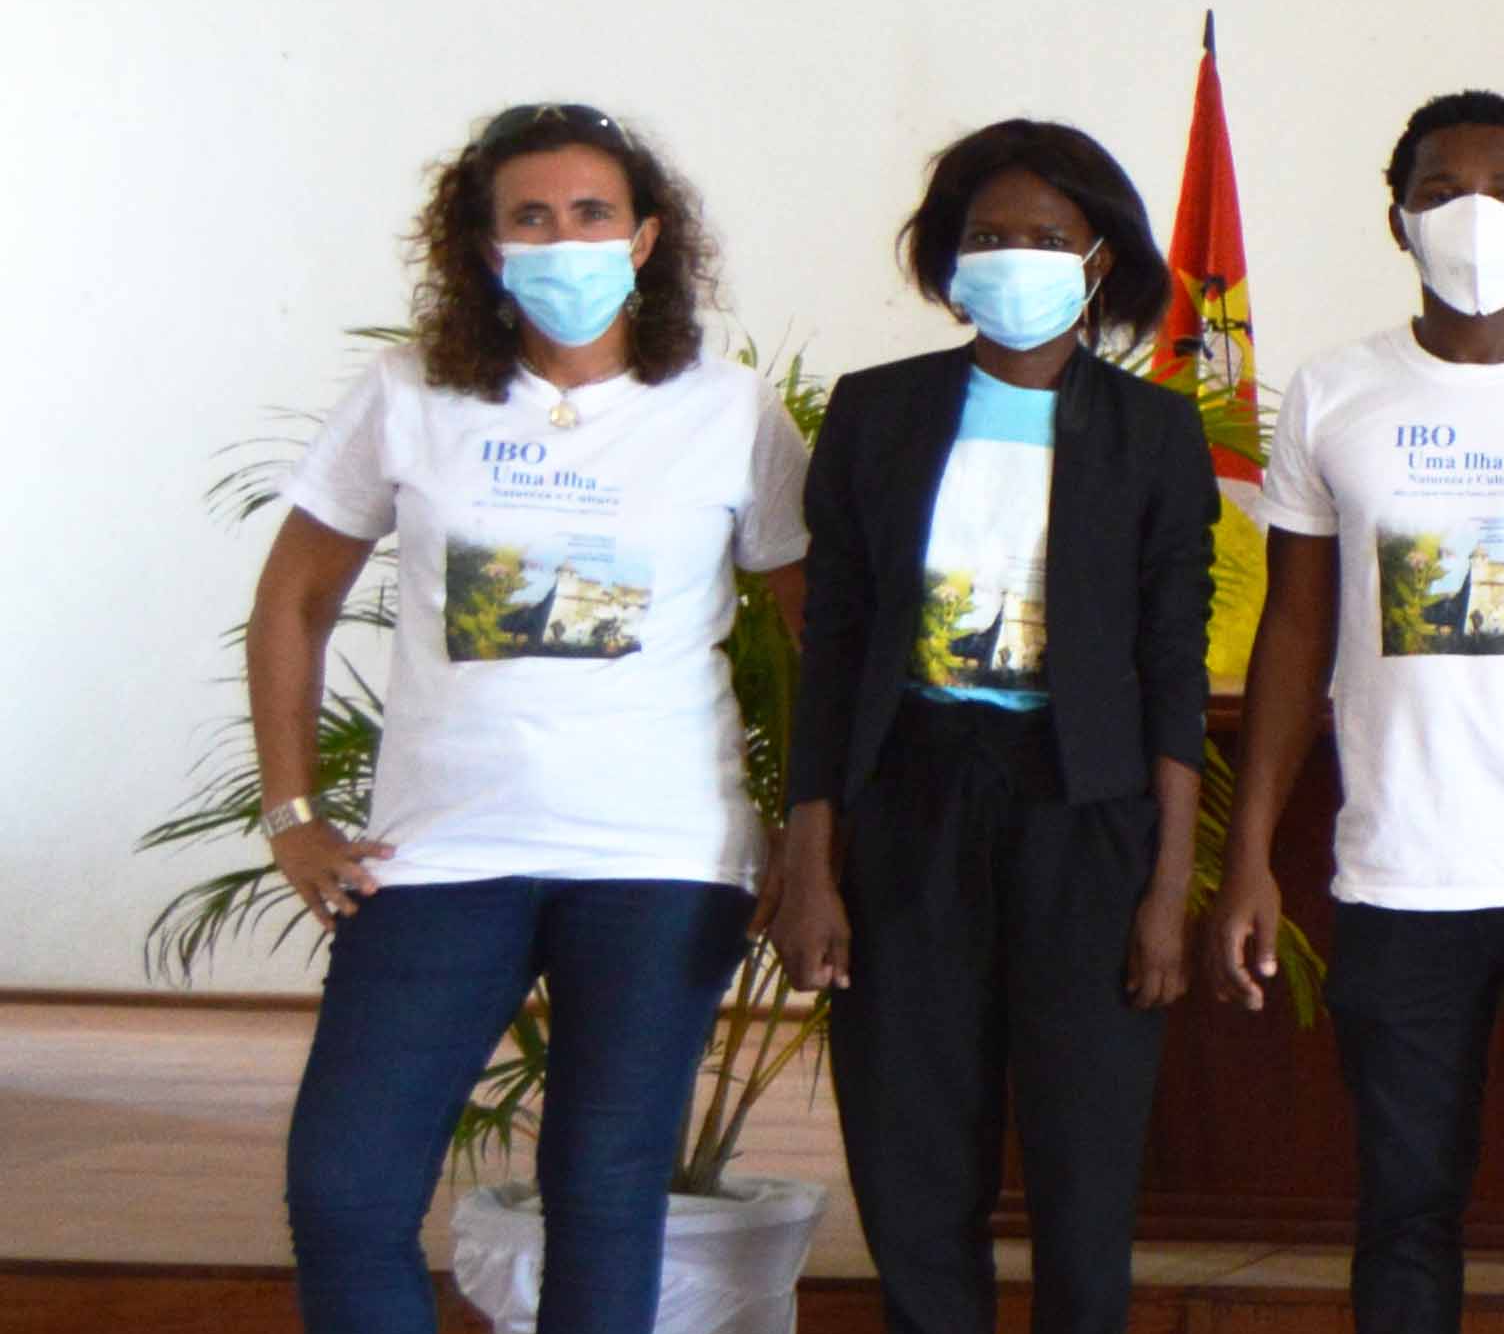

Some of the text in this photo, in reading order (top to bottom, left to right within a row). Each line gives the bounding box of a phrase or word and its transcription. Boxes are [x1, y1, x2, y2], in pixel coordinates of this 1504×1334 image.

[1395, 425, 1456, 447] IBO
[482, 441, 547, 464] IBO
[1408, 452, 1503, 469] Uma Ilha
[493, 467, 597, 490] Uma Ilha
